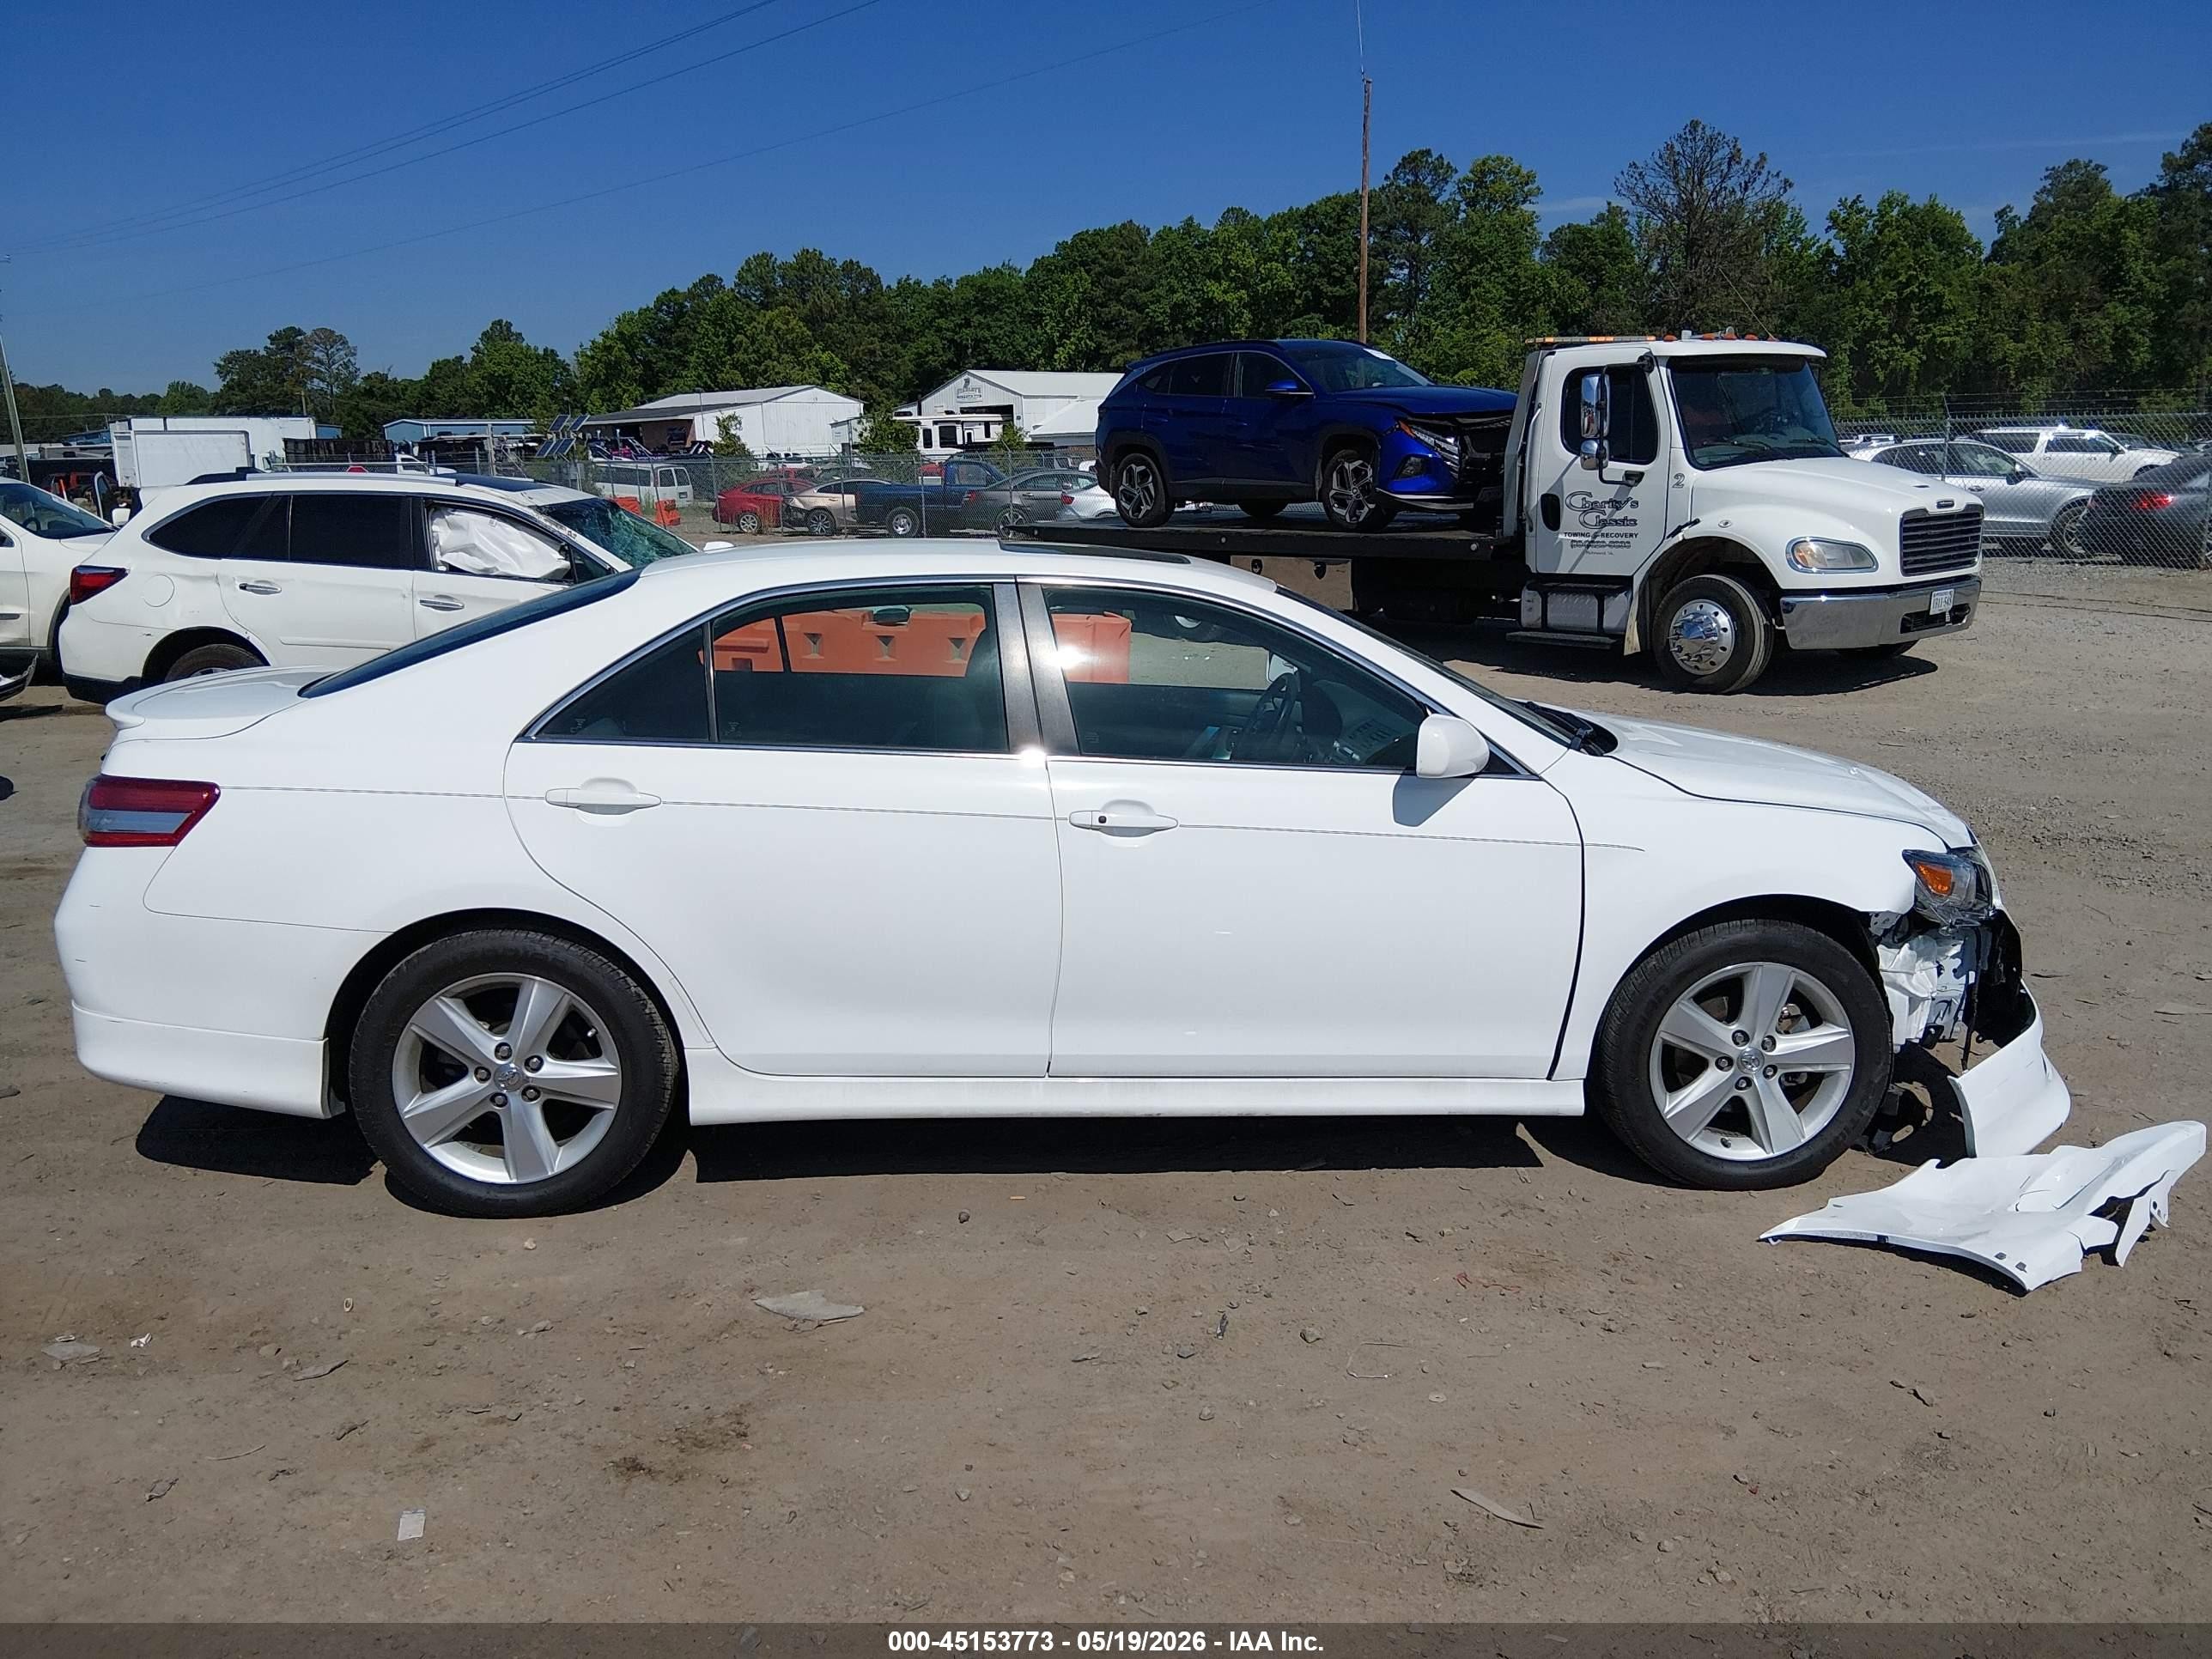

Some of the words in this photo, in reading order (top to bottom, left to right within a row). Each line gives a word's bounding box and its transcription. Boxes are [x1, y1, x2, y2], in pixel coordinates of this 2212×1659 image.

[1672, 472, 1686, 489] 2
[1565, 490, 1639, 512] Charity's
[1578, 509, 1638, 530] Classic
